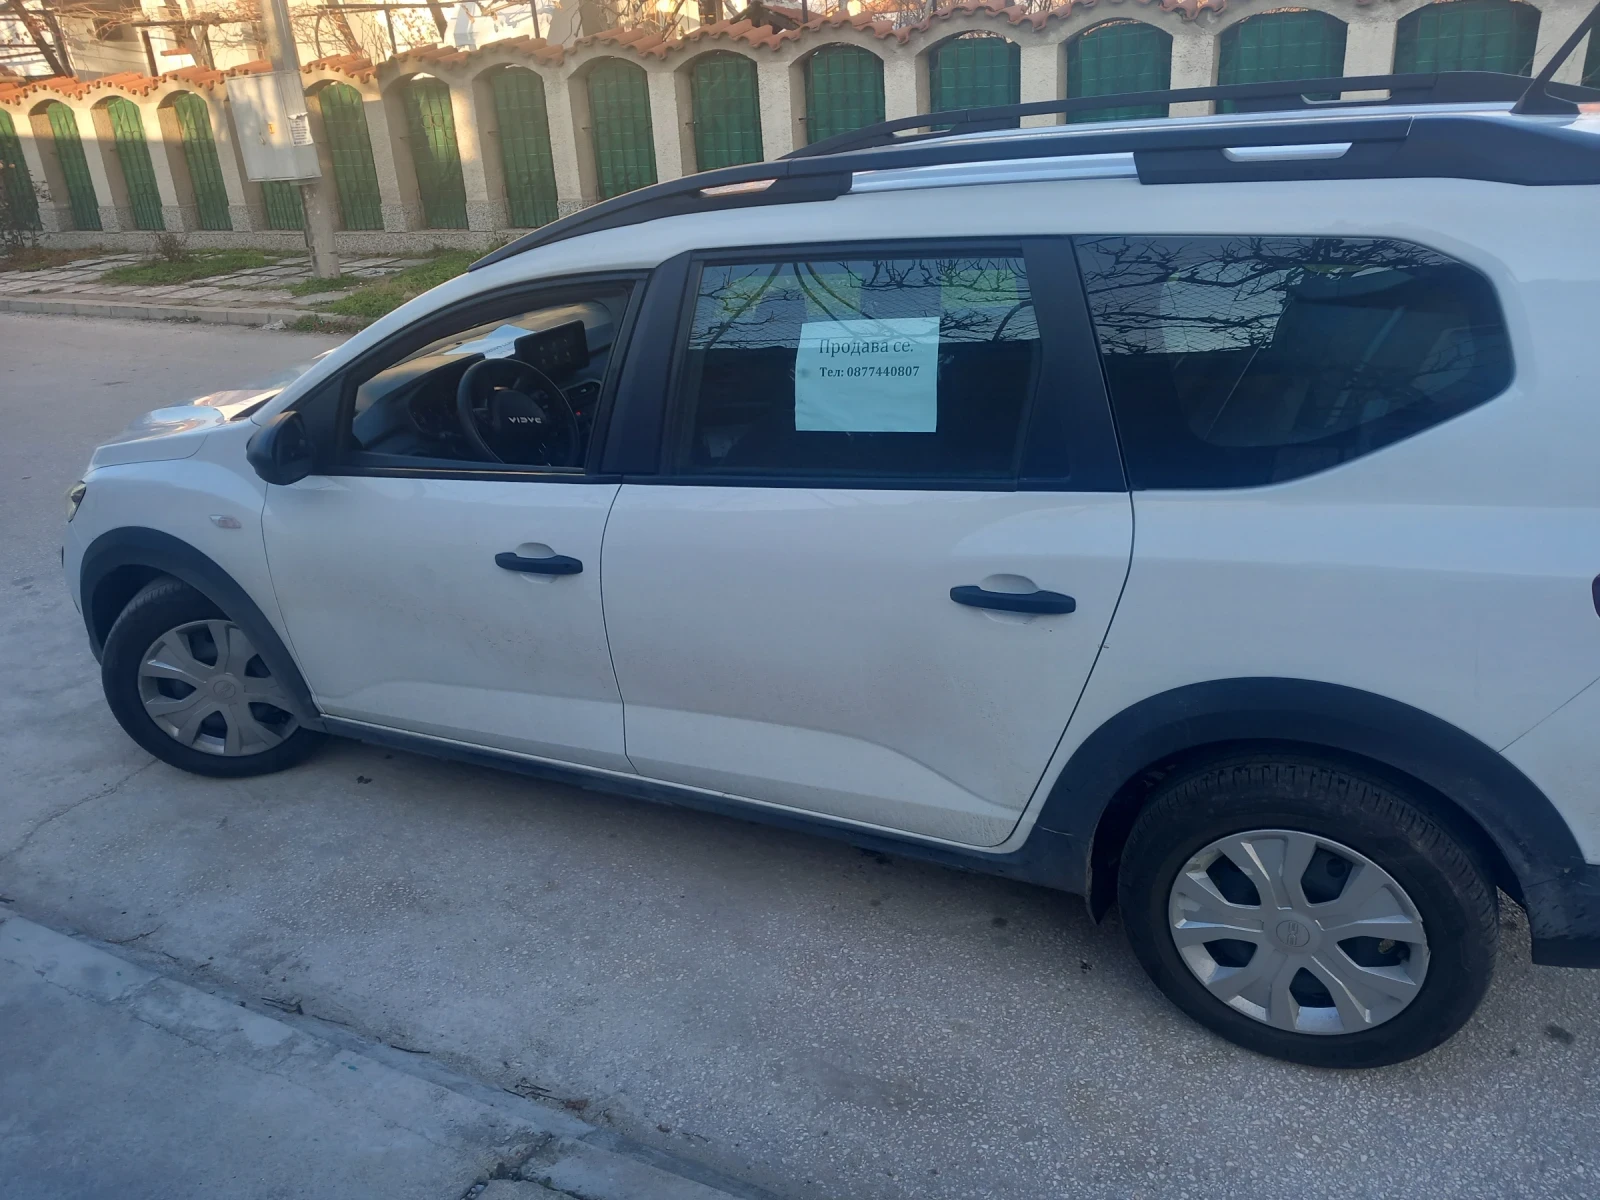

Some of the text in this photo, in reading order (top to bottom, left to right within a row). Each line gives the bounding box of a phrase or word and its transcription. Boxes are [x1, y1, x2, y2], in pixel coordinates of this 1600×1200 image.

[819, 339, 914, 357] Продава се.
[819, 366, 920, 377] Тел: 0877440807
